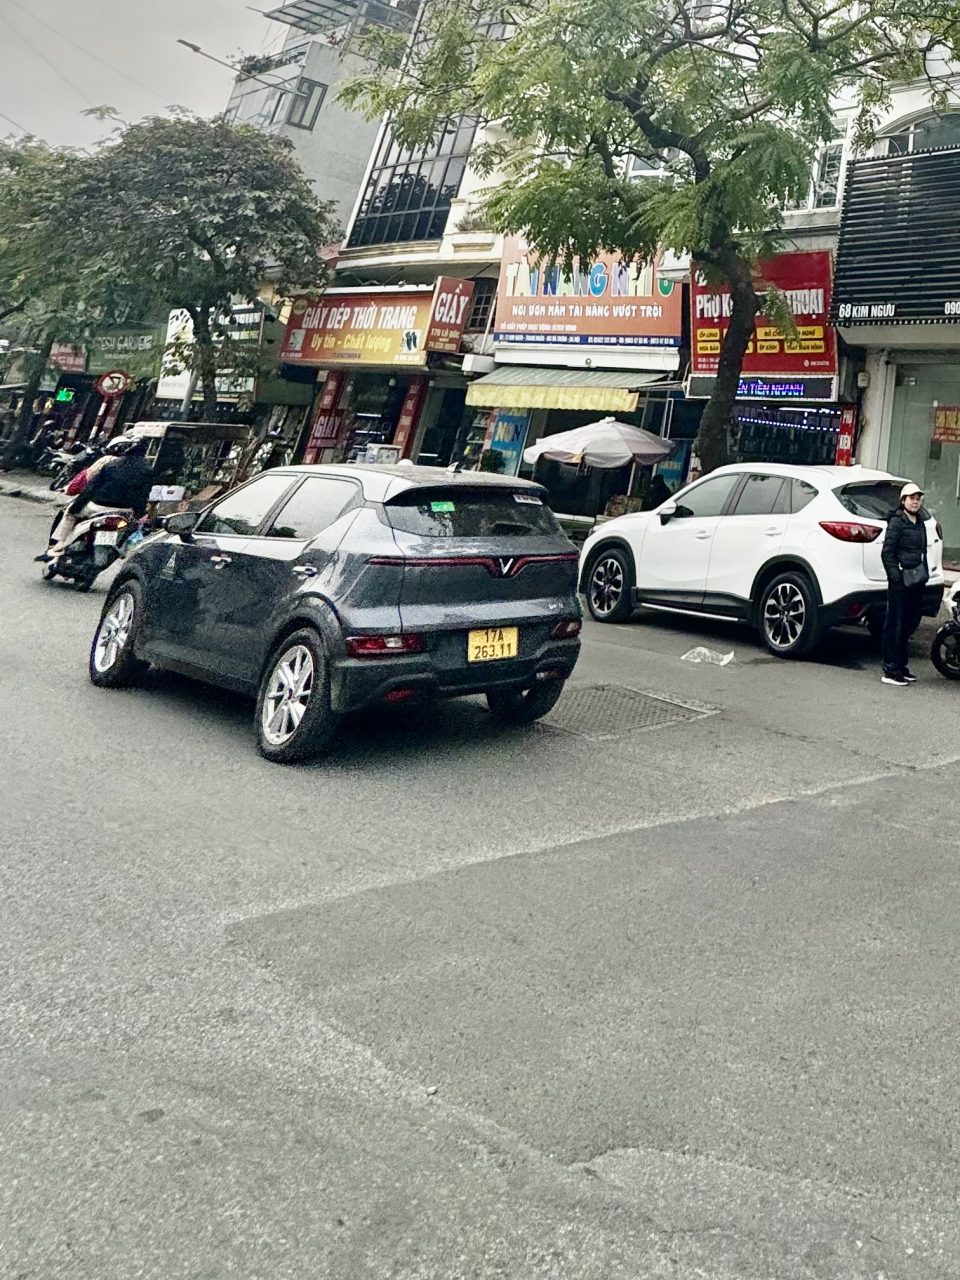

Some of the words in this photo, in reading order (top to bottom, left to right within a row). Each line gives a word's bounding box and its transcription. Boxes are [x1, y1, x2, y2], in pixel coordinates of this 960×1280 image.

[326, 302, 351, 329] DÉP
[350, 301, 378, 329] THỜI
[377, 305, 417, 329] TRANG
[568, 303, 583, 317] TÀI
[612, 304, 637, 319] VƯỢT
[639, 302, 663, 320] TRỘI
[696, 294, 721, 322] PHỤ
[838, 303, 851, 318] 68
[852, 305, 868, 317] KIM
[870, 303, 895, 317] NGƯU
[310, 333, 323, 351] Uy
[323, 332, 336, 347] tín
[343, 329, 364, 349] Chất
[365, 333, 392, 353] lượng
[485, 629, 504, 642] 17A
[474, 643, 512, 659] 263.11
